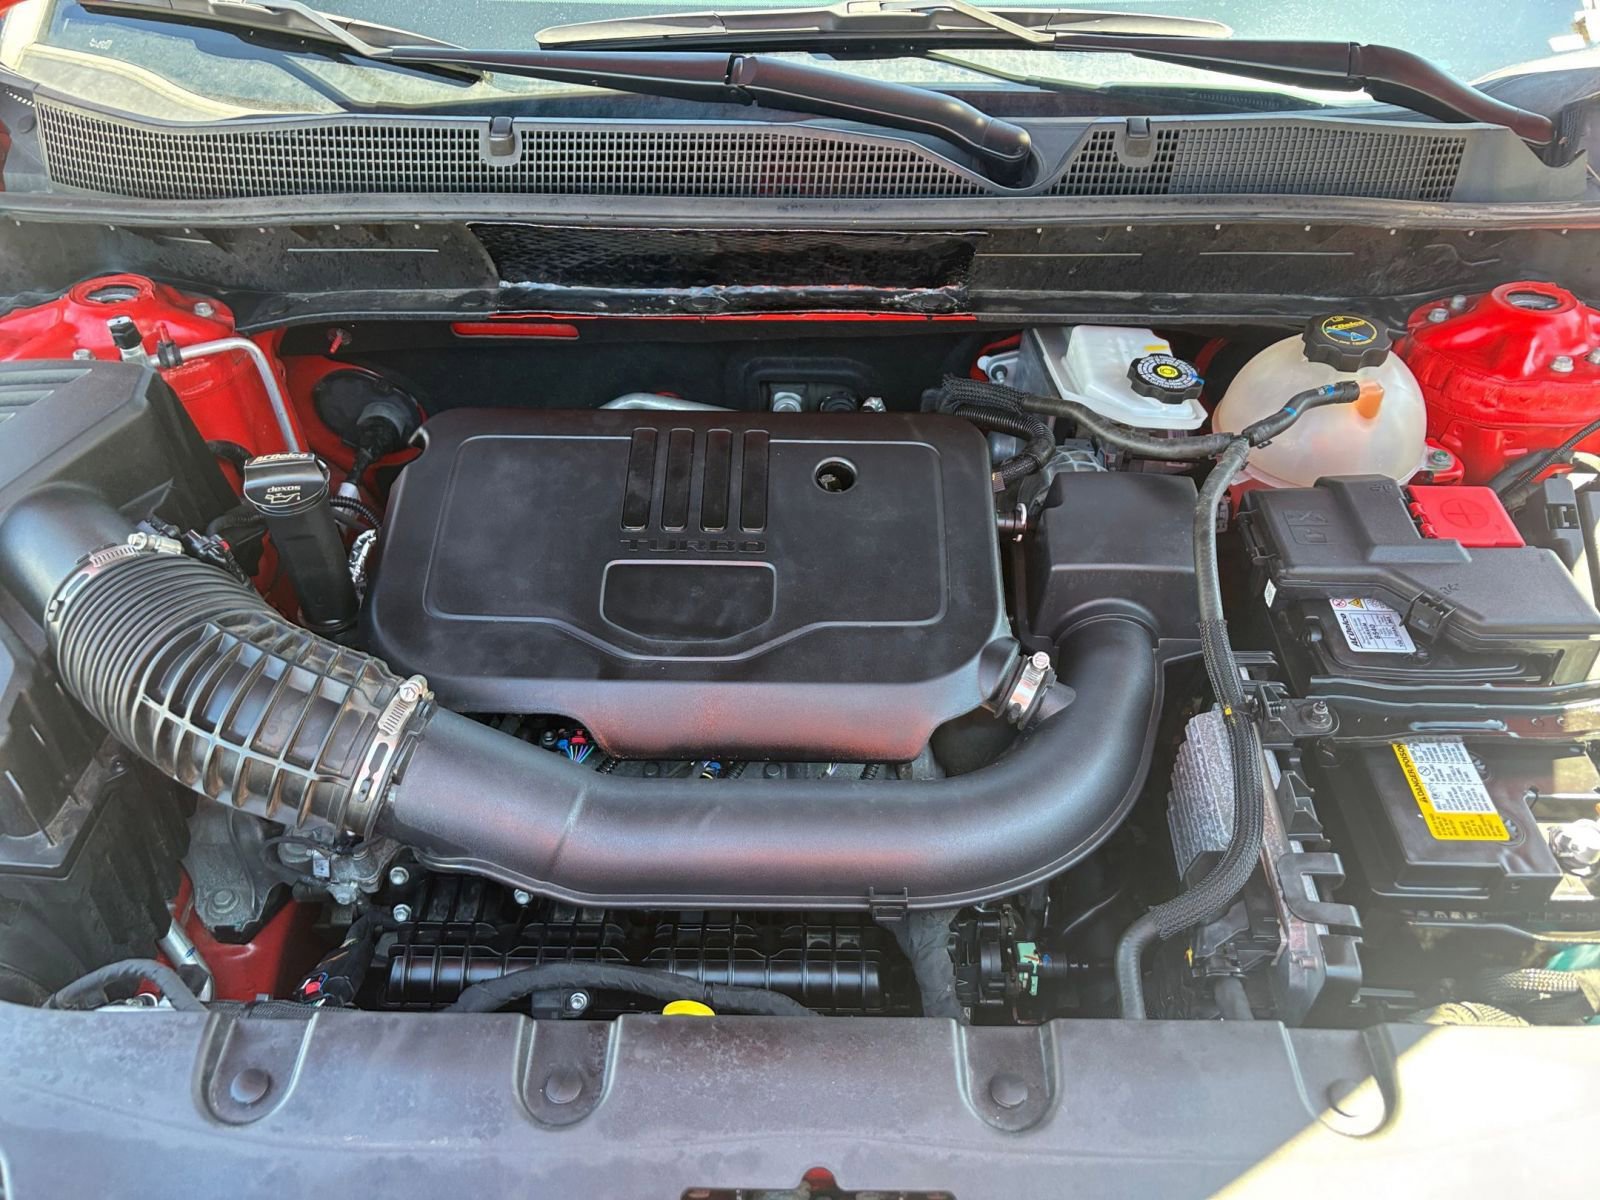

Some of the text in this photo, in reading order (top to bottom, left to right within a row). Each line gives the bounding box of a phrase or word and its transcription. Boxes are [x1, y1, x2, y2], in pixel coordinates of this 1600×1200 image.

[249, 453, 308, 465] ACDelco
[267, 485, 301, 493] dexos
[619, 539, 767, 553] TURBO
[1340, 613, 1360, 647] ACDelco
[1395, 743, 1425, 795] DANGER POISON
